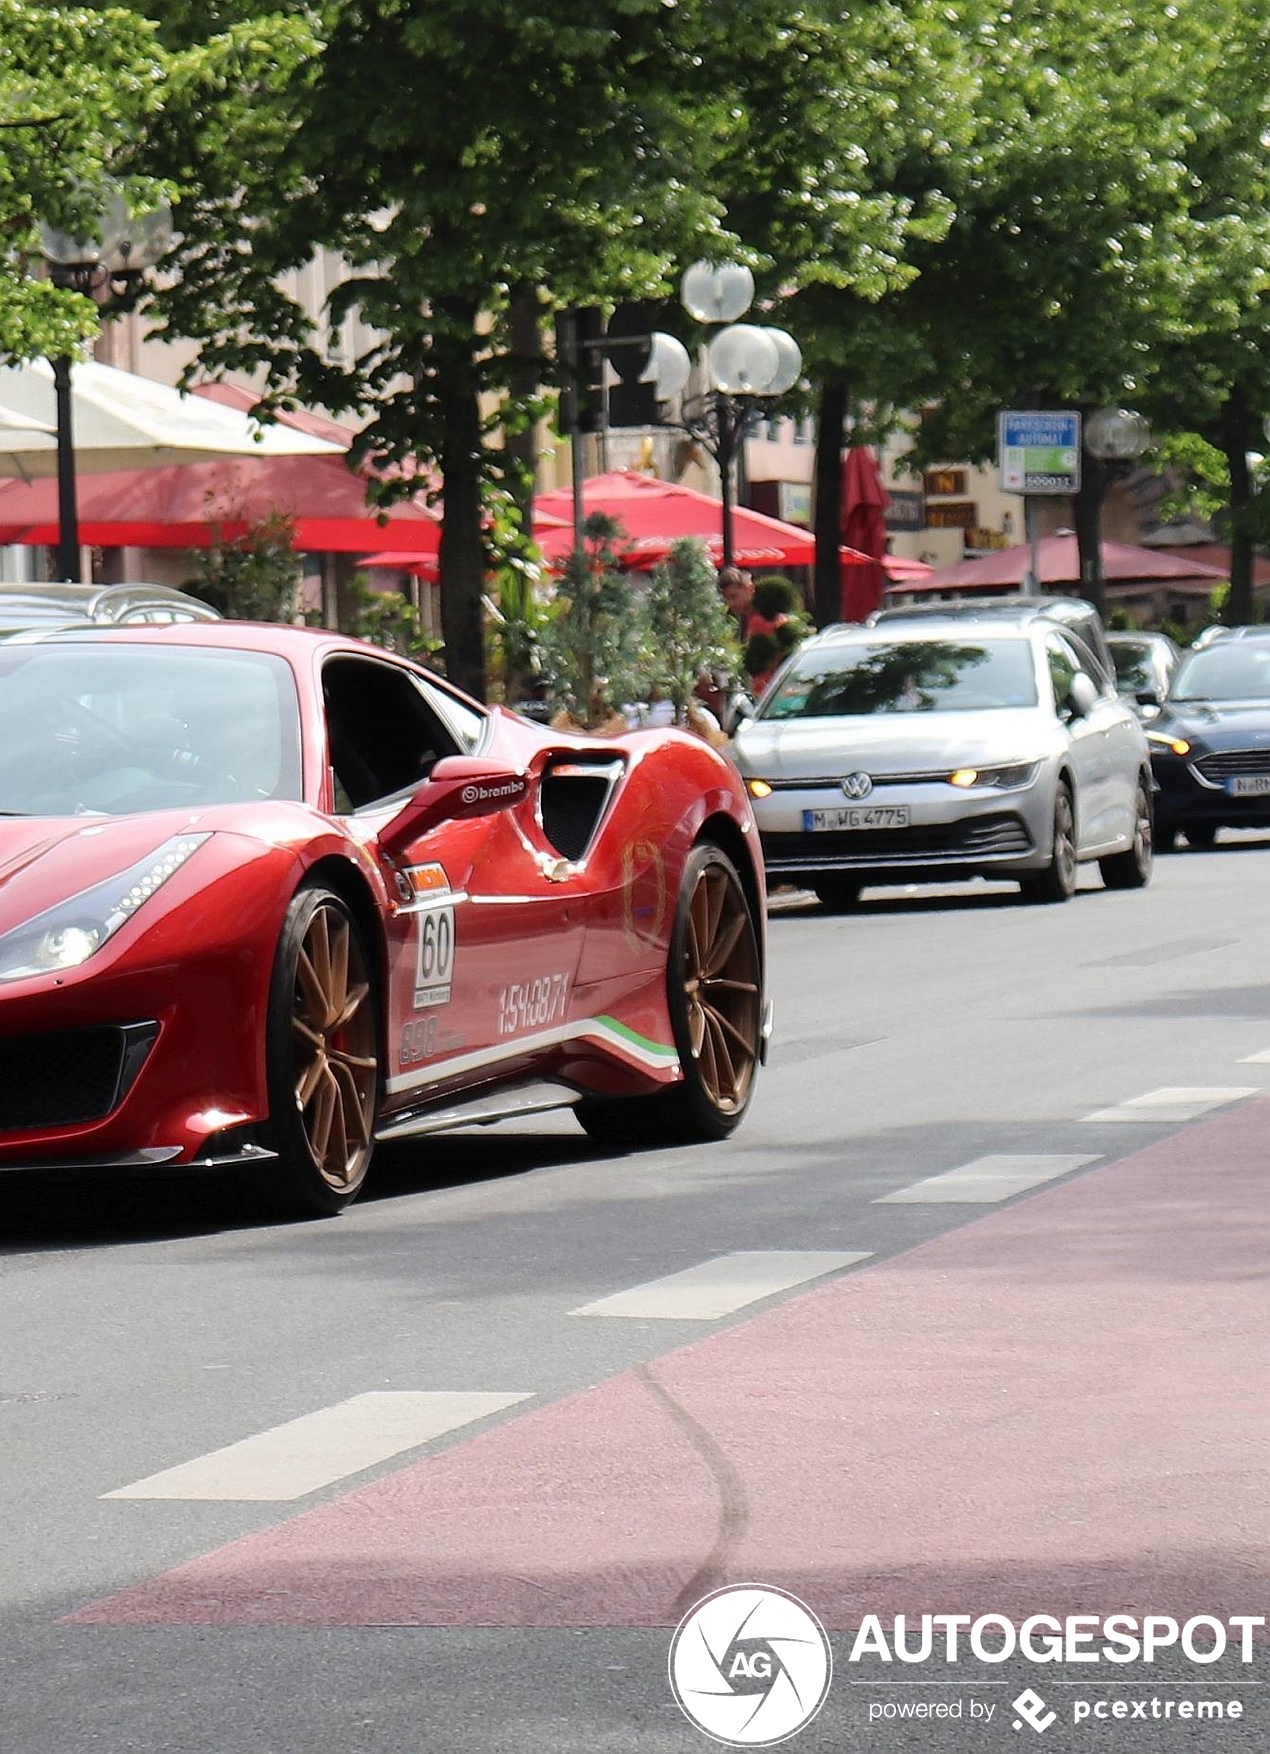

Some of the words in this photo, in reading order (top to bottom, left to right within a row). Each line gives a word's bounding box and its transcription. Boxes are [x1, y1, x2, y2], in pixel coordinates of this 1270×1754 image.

[479, 781, 525, 799] brembo
[814, 812, 826, 828] M
[838, 810, 860, 827] WG
[864, 808, 907, 825] 4775
[421, 912, 450, 979] 60
